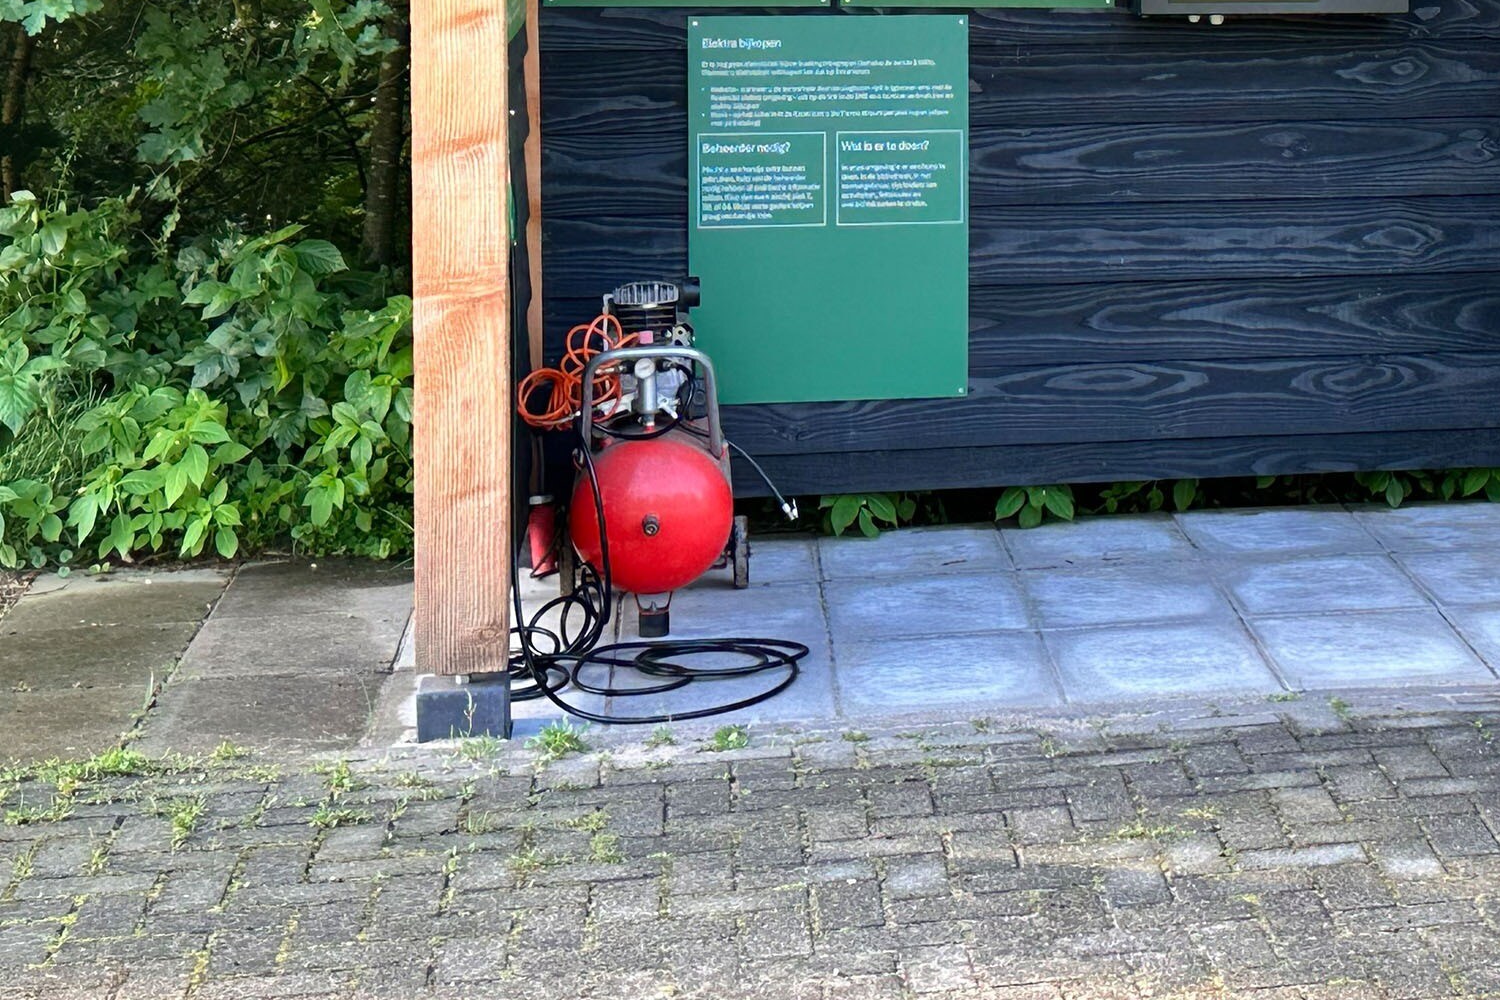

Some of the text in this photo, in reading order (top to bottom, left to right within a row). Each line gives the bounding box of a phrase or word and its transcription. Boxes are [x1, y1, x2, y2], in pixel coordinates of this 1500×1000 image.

[739, 39, 781, 49] bijkopen
[702, 142, 790, 154] Beheerder nodig?
[841, 141, 862, 151] Wat
[864, 142, 872, 151] is
[887, 142, 896, 150] te
[899, 141, 929, 151] doen?
